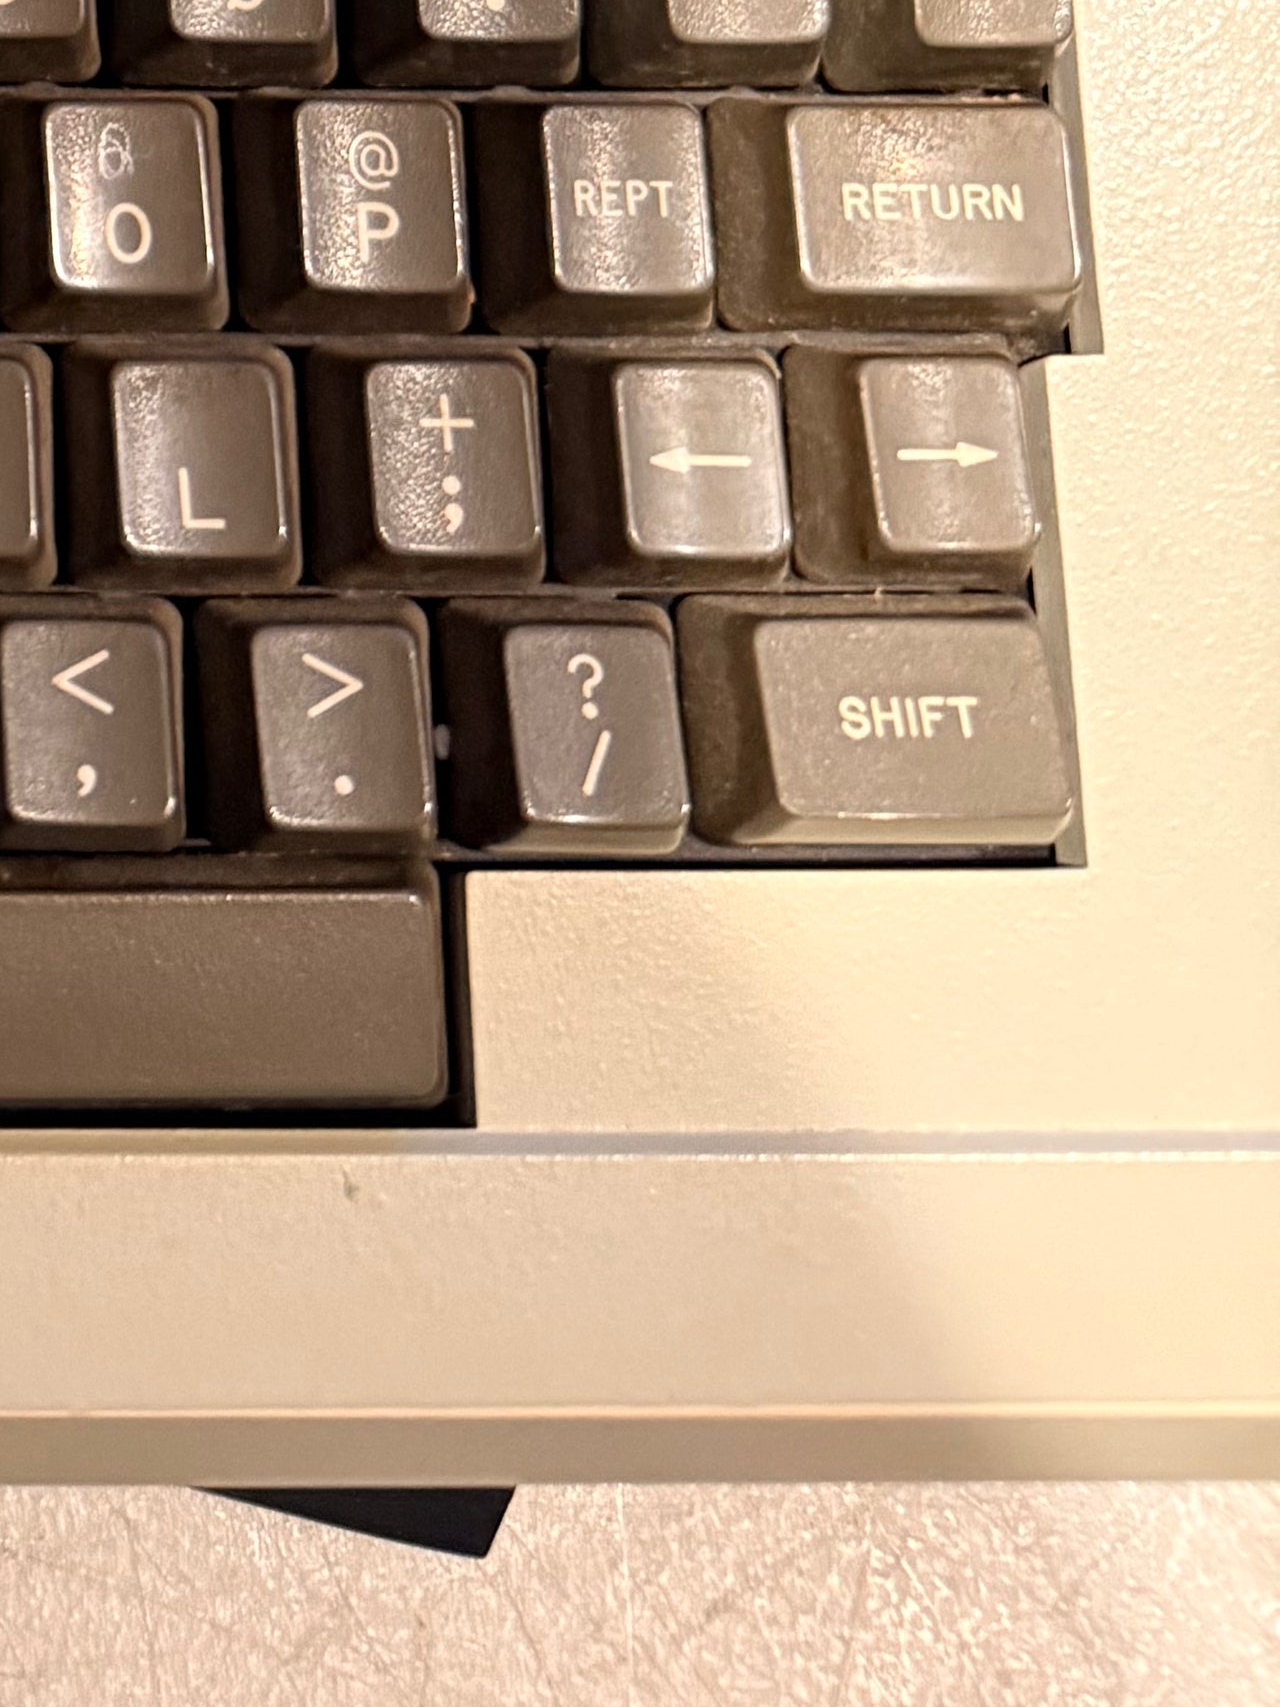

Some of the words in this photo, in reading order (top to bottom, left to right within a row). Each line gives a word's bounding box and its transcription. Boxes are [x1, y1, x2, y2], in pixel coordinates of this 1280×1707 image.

[348, 130, 400, 190] @
[574, 179, 674, 219] REPT
[842, 182, 1025, 222] RETURN
[104, 202, 152, 264] O
[356, 202, 400, 264] P
[419, 393, 475, 453] +
[178, 467, 227, 530] L
[442, 474, 465, 533] ;
[51, 648, 115, 715] <
[302, 652, 365, 719] >
[567, 653, 604, 720] ?
[838, 695, 979, 741] SHIFT
[582, 729, 611, 797] /
